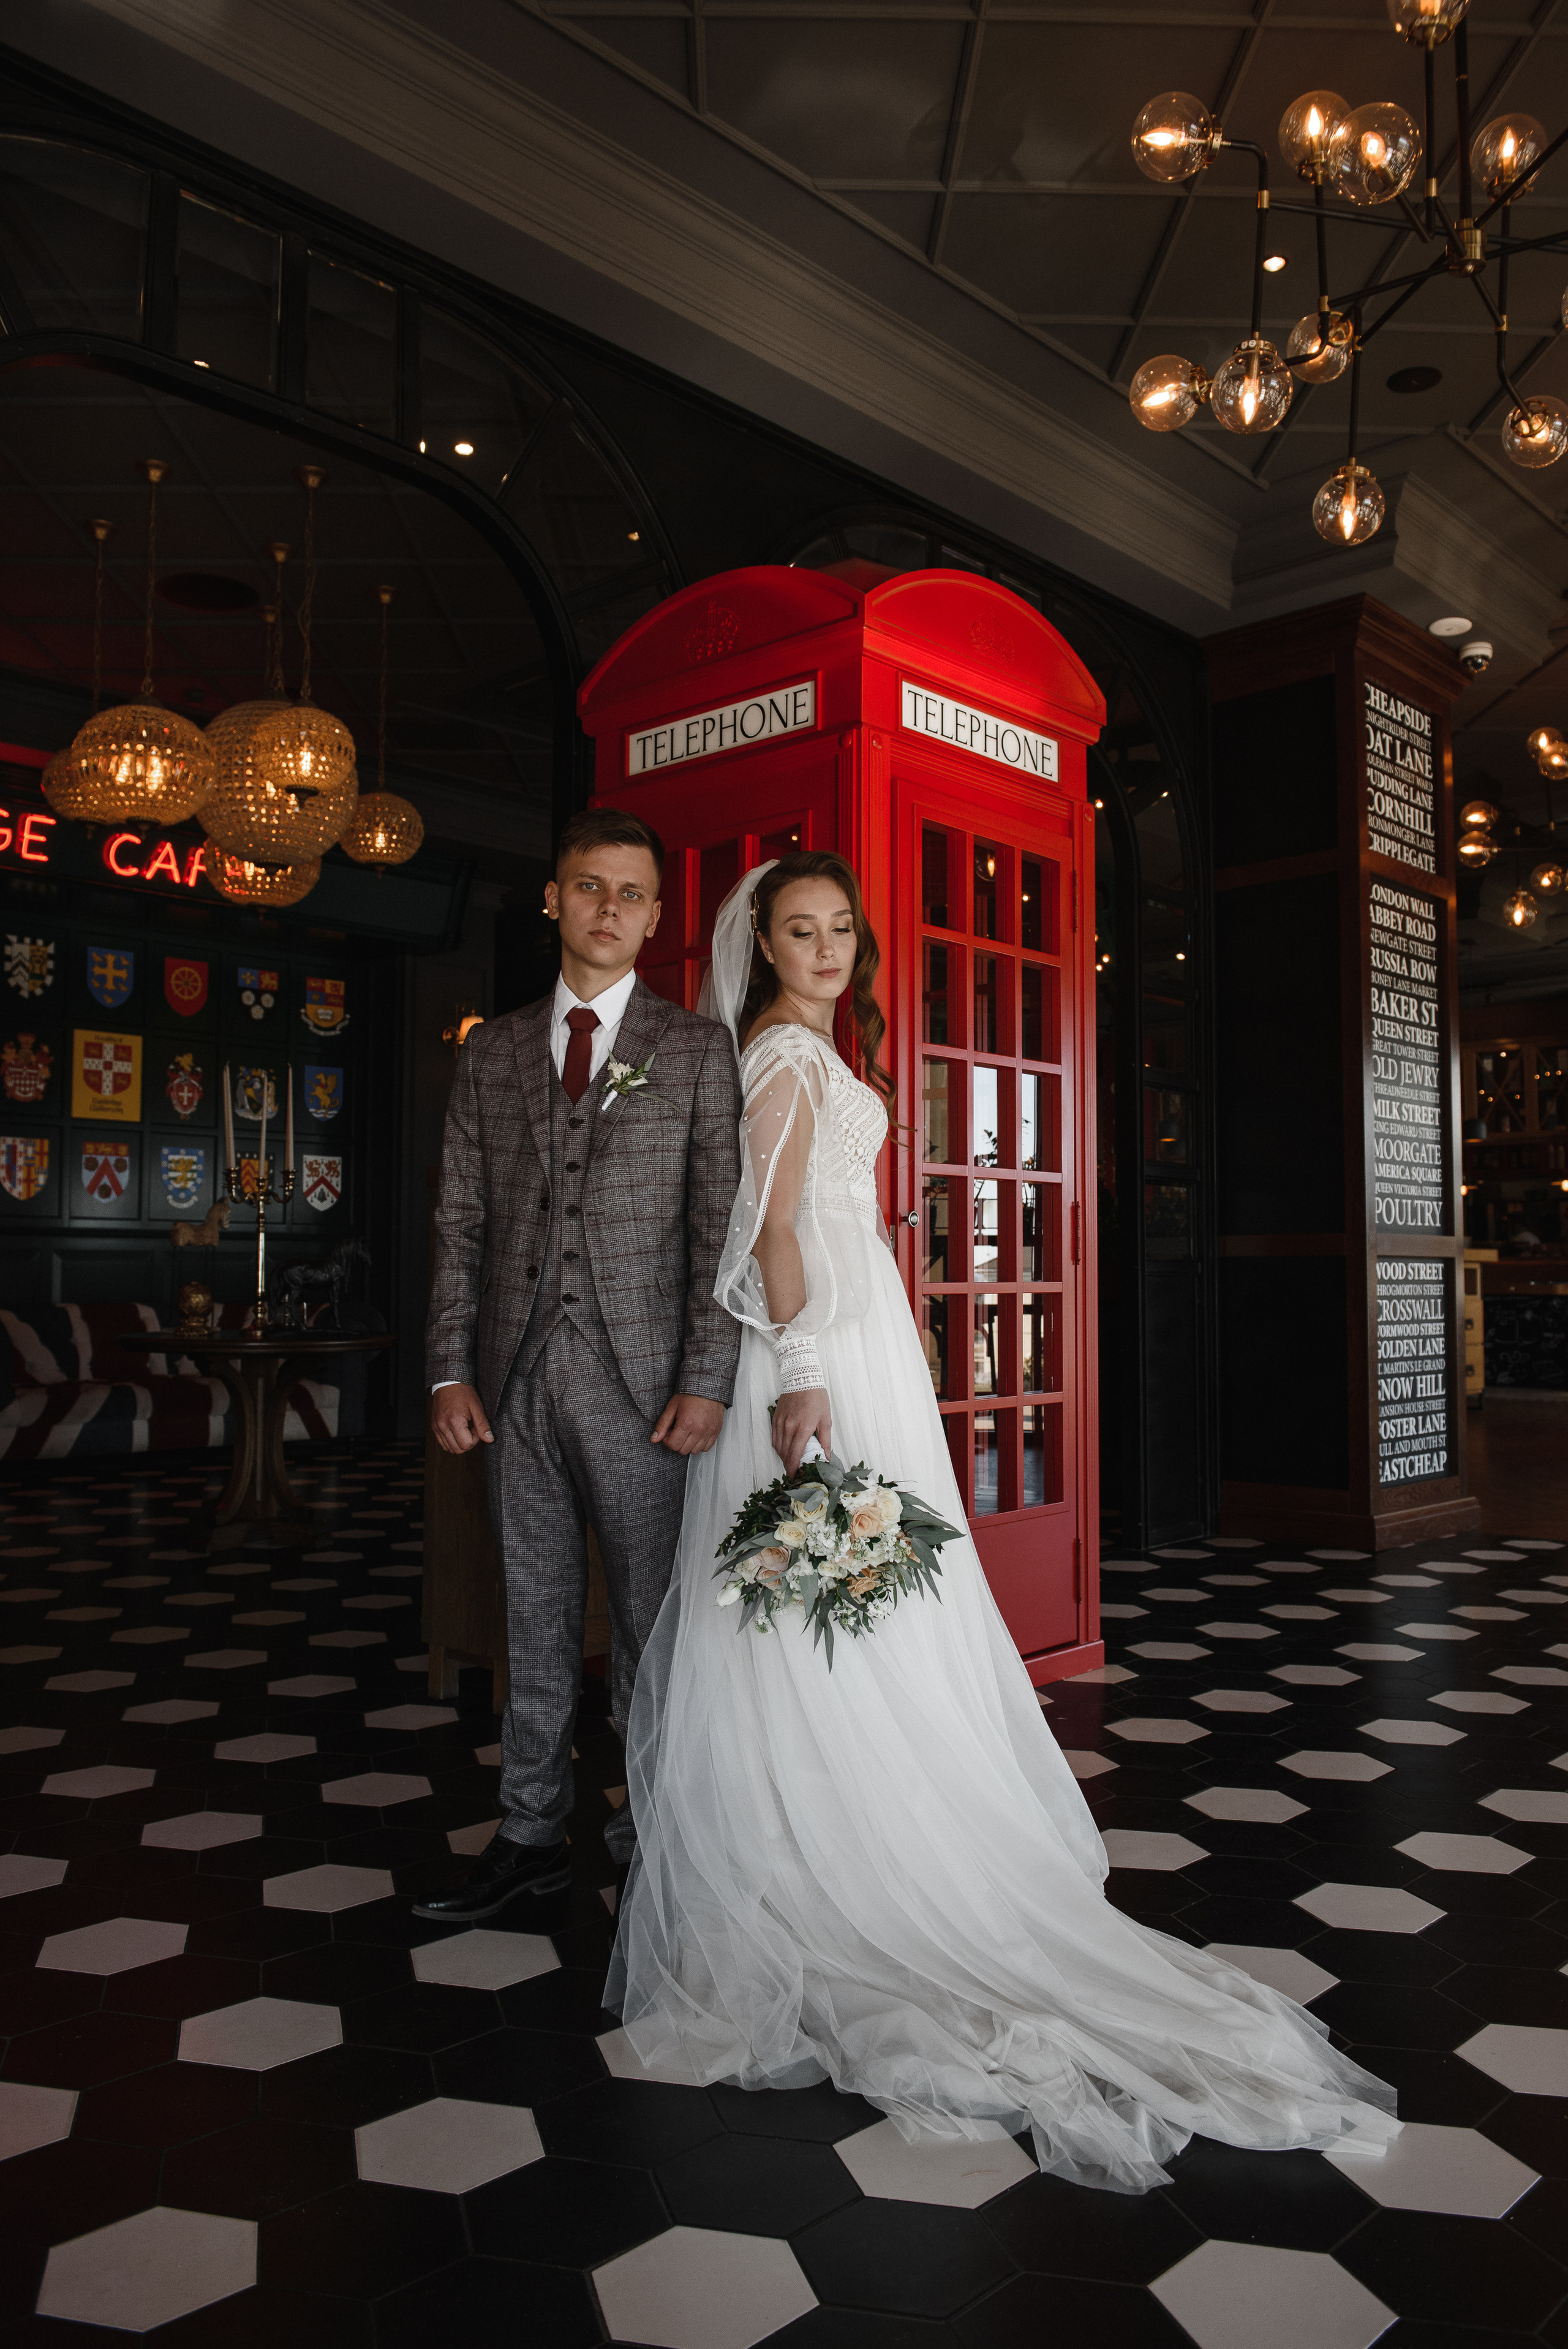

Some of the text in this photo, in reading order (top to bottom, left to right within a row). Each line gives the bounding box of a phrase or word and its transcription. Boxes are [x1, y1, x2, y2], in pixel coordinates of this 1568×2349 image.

[636, 689, 810, 769] TELEPHONE
[907, 690, 1054, 777] TELEPHONE
[1409, 731, 1431, 752] STREET
[1395, 739, 1433, 779] LANE
[1394, 765, 1414, 785] STREET
[1414, 774, 1433, 792] WARD
[1409, 785, 1433, 811] LANE
[1416, 833, 1435, 852] LANE
[109, 834, 207, 887] CAF
[1370, 883, 1435, 921] ONDON WALL
[1405, 915, 1436, 942] ROAD
[1408, 939, 1436, 961] STREET
[1410, 958, 1437, 983] ROW
[1392, 977, 1411, 993] LANE
[1411, 982, 1438, 1000] MARKET
[1371, 987, 1438, 1027] BAKER ST
[1404, 1024, 1439, 1048] STREET
[1392, 1043, 1416, 1059] TOWER
[1416, 1048, 1439, 1064] STREET
[1372, 1055, 1439, 1088] OLD JEWRY
[1419, 1090, 1440, 1104] STREET
[1401, 1102, 1441, 1125] STREET
[1389, 1122, 1419, 1138] EDWARD
[1419, 1126, 1441, 1140] STREET
[1411, 1166, 1442, 1183] SQUARE
[1393, 1183, 1421, 1196] VICTORIA
[1422, 1186, 1442, 1197] STREET
[1374, 1197, 1442, 1227] POULTRY
[1407, 1262, 1444, 1280] STREET
[1422, 1284, 1444, 1295] STREET
[1377, 1322, 1445, 1337] ORMWOOD STREET
[1417, 1337, 1445, 1356] LANE
[1414, 1360, 1422, 1372] LE
[1422, 1358, 1446, 1371] GRAND
[1415, 1374, 1446, 1398] HILL
[1379, 1399, 1446, 1417] ANSION HOUSE STREET
[1378, 1412, 1446, 1440] OSTER LANE
[1393, 1439, 1411, 1454] AND
[1410, 1435, 1438, 1453] MOUTH
[1437, 1434, 1447, 1447] ST
